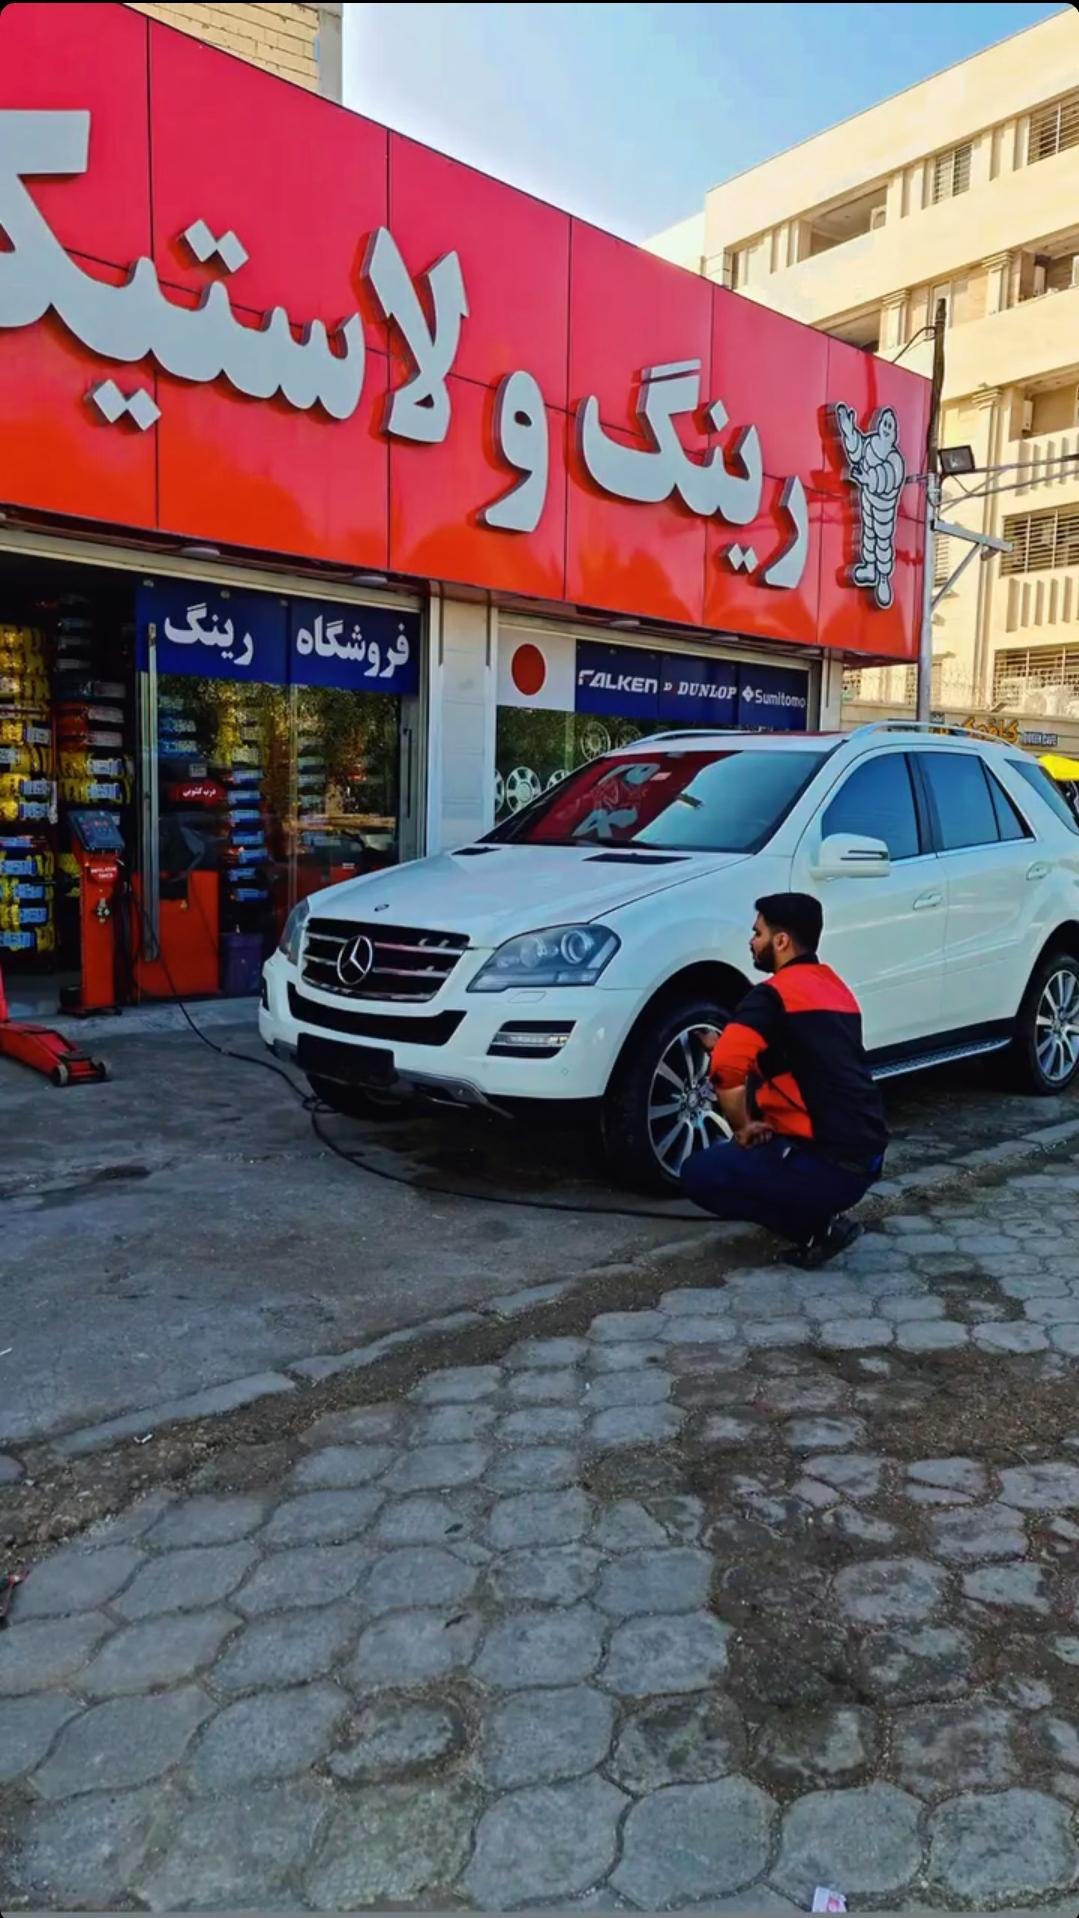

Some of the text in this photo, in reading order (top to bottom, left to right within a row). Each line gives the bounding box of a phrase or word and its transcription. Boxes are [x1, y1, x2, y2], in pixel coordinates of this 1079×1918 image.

[480, 371, 548, 532] و
[578, 359, 808, 588] رینگ
[164, 603, 409, 677] فروشگاه رینگ
[578, 669, 657, 693] FALKEN
[677, 682, 737, 699] DUNLOP
[755, 690, 806, 708] Sumitomo
